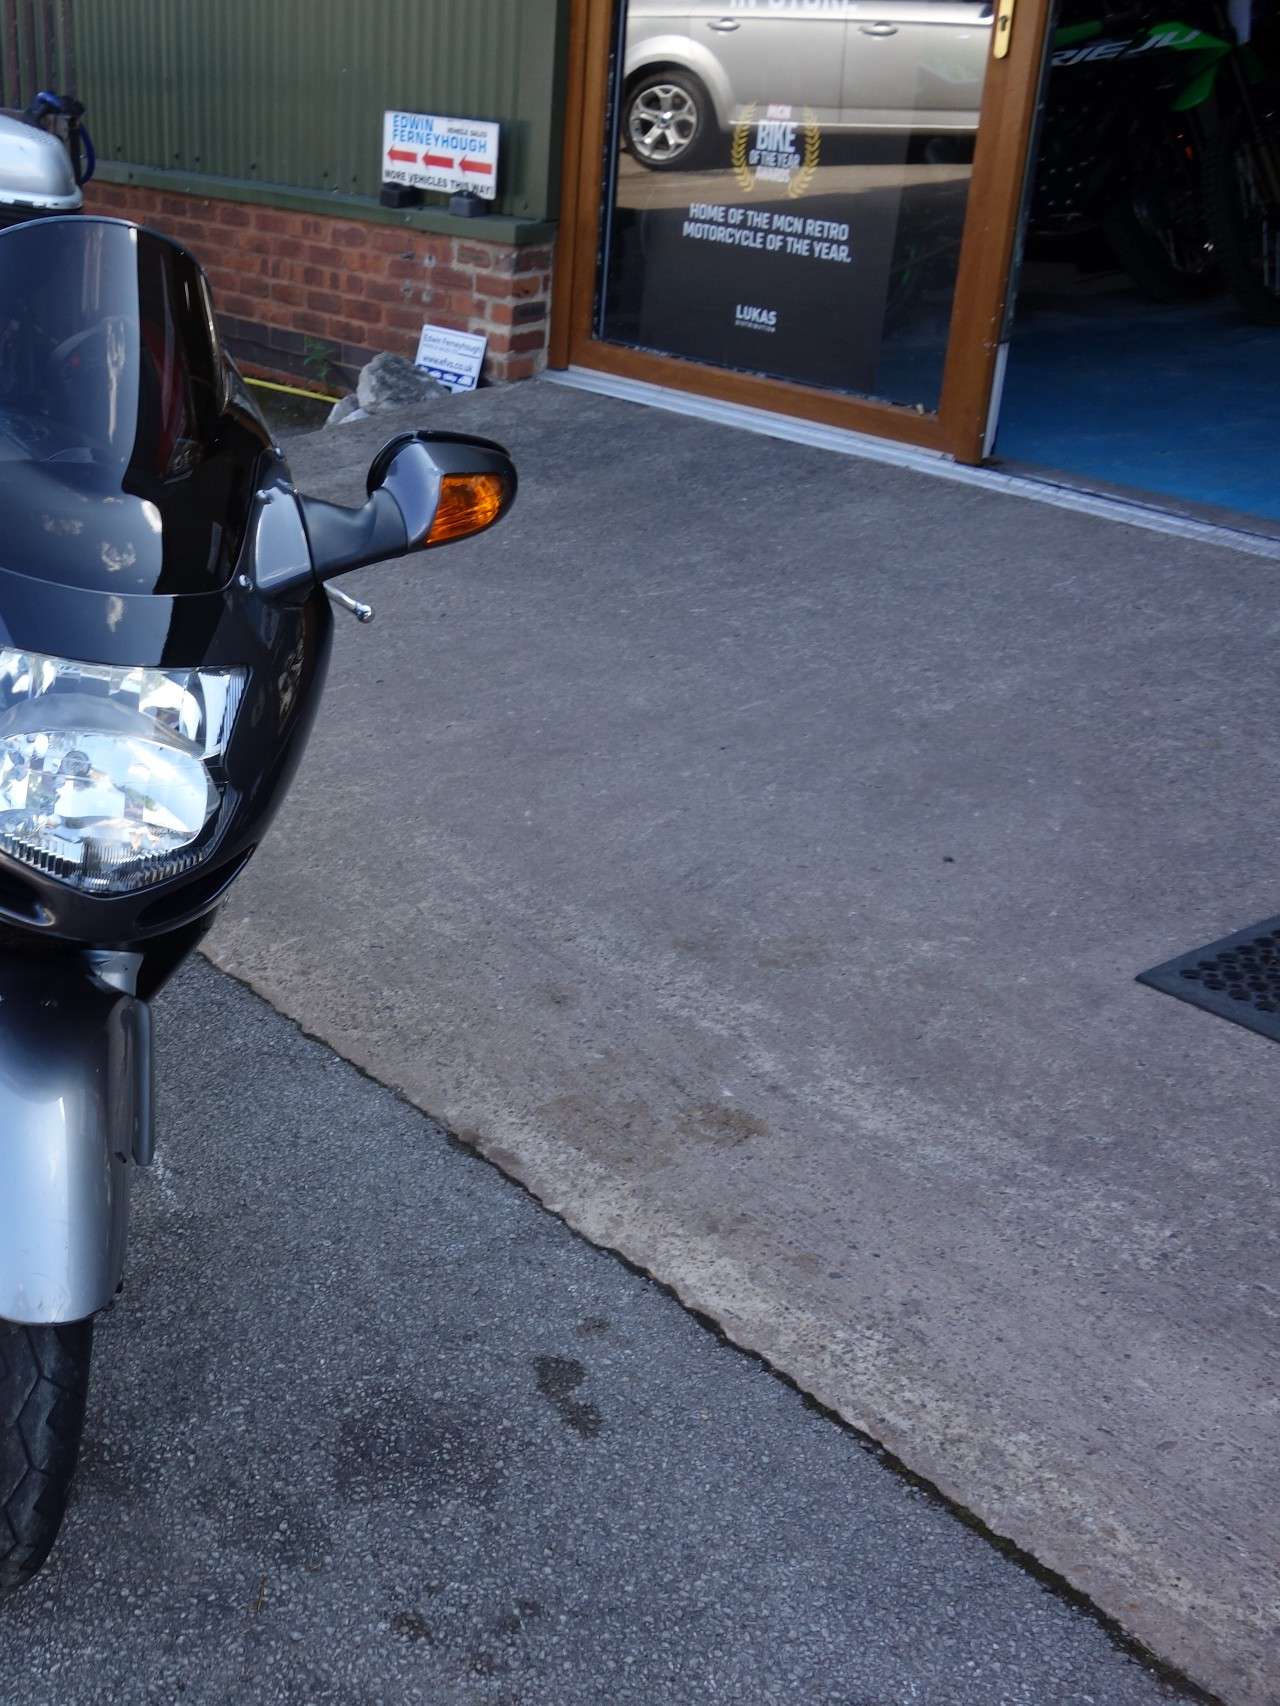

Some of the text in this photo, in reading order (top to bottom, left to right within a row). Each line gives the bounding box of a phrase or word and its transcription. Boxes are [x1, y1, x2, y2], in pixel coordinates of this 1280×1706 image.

[392, 114, 433, 132] EDWIN
[392, 128, 487, 153] FERNEYHOUGH
[756, 120, 798, 153] BIKE
[748, 149, 801, 170] OF THE YEAR
[384, 169, 406, 181] MORE
[408, 173, 448, 189] VEHICLES
[689, 203, 849, 241] HOME OF THE MCN RETRO
[682, 221, 852, 263] MOTORCYCLE OF THE YEAR.
[736, 304, 777, 326] LUKAS
